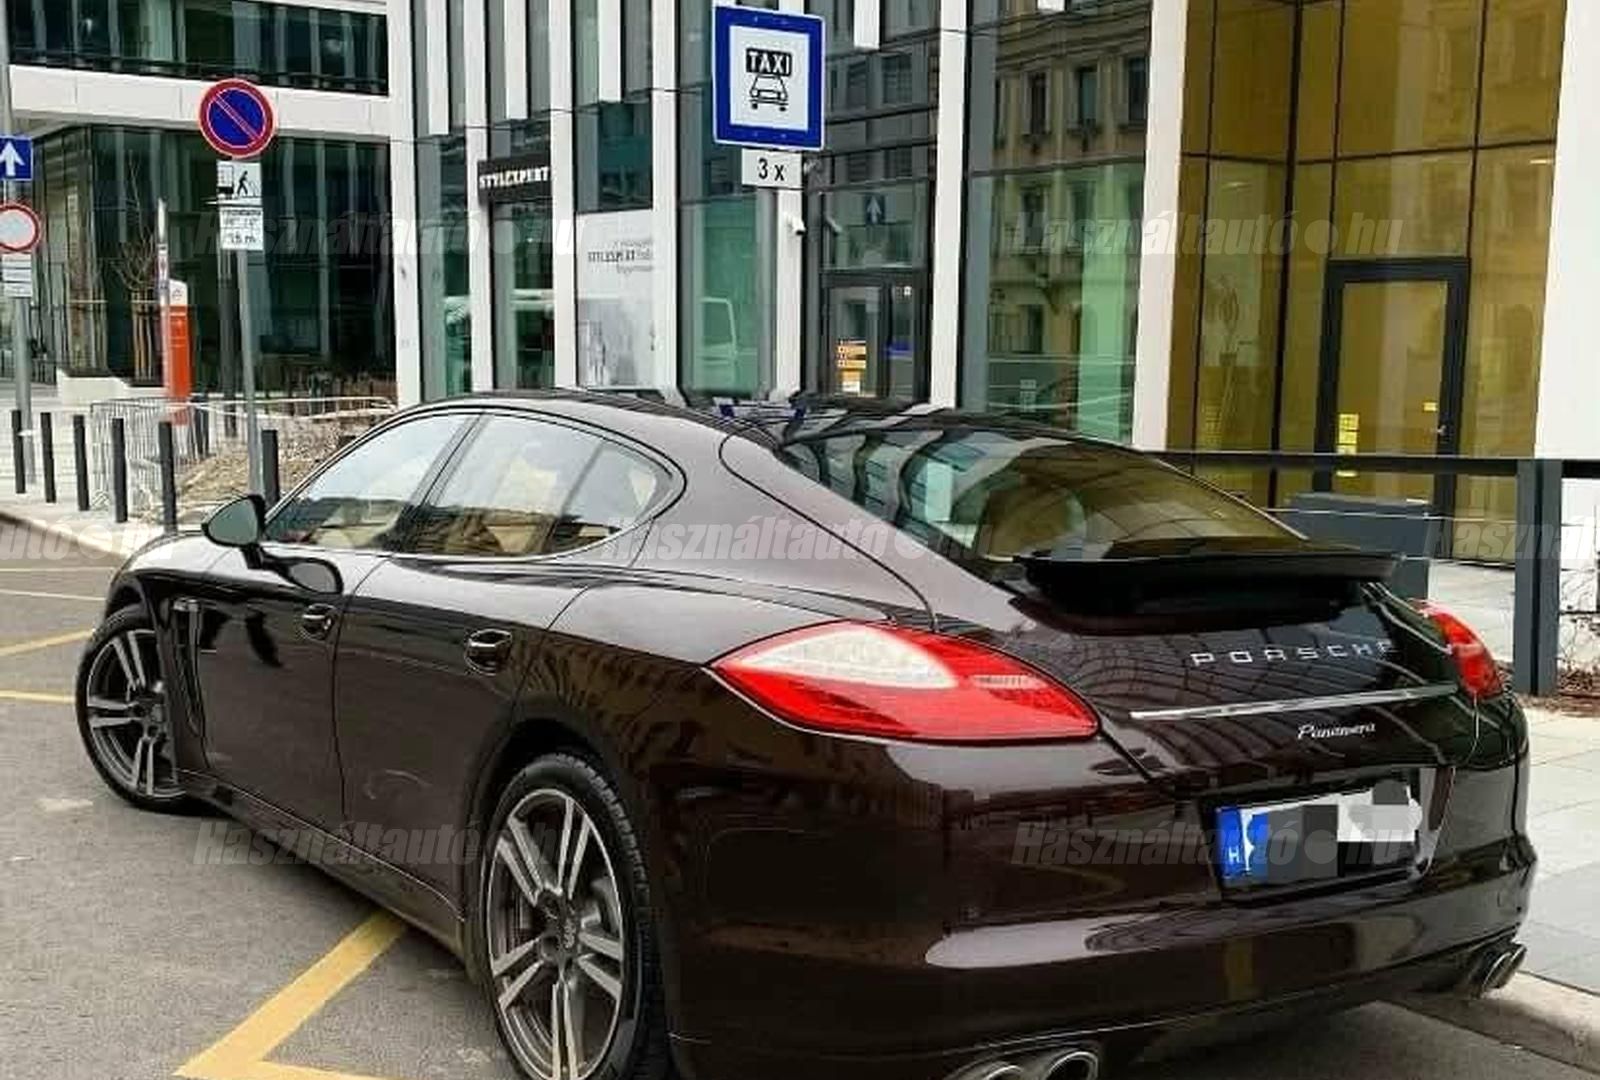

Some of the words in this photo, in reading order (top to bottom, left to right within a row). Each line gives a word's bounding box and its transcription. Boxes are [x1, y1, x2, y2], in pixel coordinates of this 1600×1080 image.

[748, 51, 791, 77] TAXI
[758, 158, 768, 180] 3
[1189, 639, 1393, 667] PORSCHE
[1297, 721, 1377, 740] Panamera
[1229, 845, 1240, 865] H
